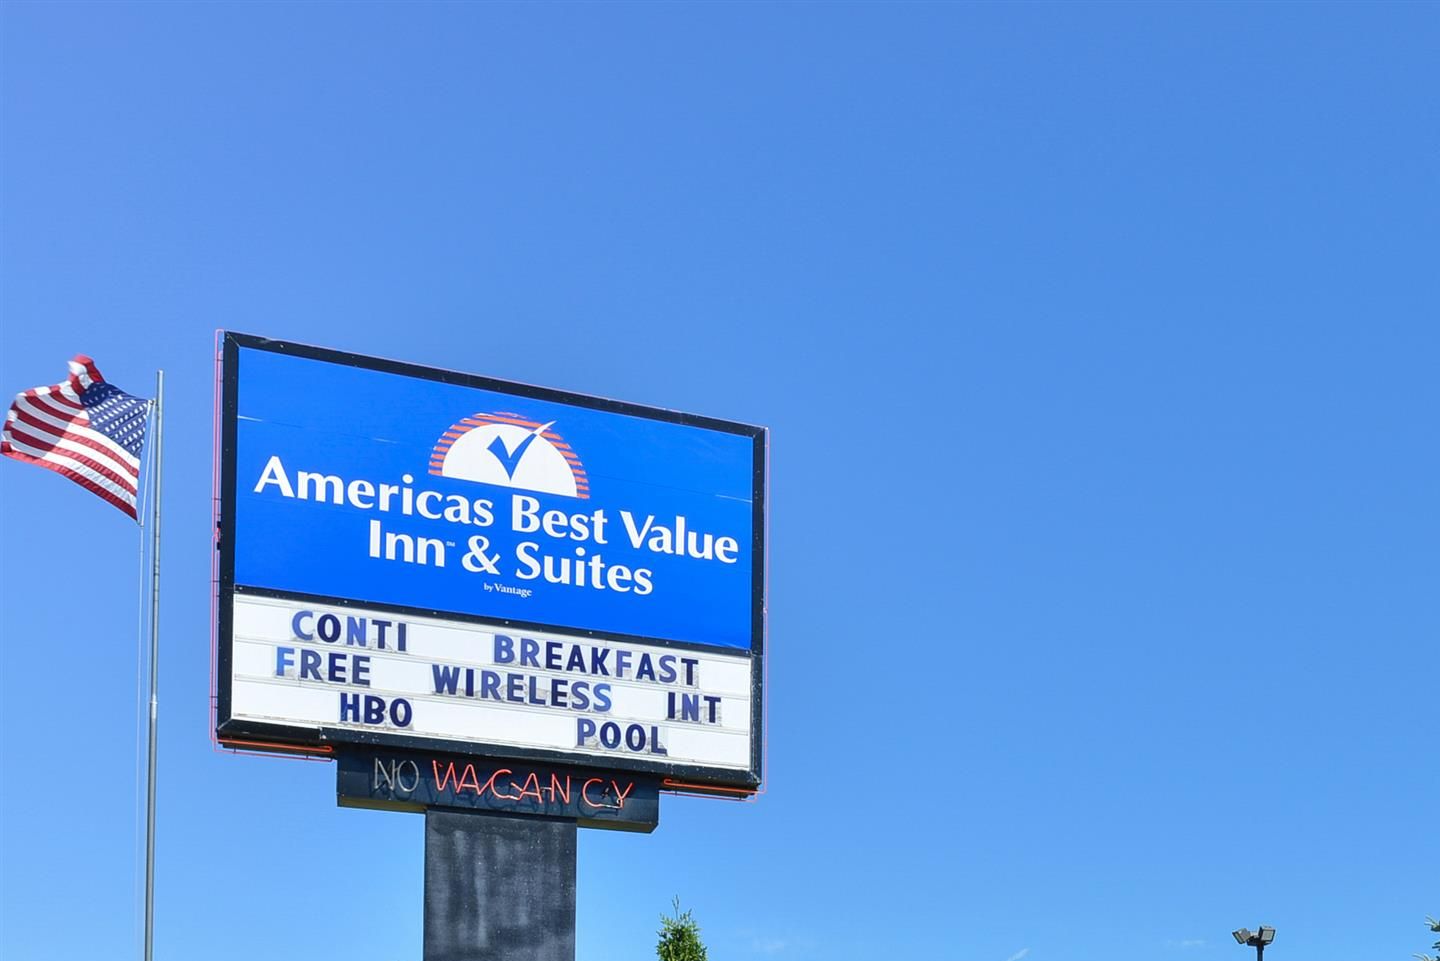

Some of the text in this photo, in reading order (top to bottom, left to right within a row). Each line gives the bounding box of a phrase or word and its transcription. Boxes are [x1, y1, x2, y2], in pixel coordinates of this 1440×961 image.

[254, 455, 739, 564] Americas Best Value
[369, 519, 445, 567] Inn
[461, 535, 501, 575] &
[515, 541, 653, 595] Suites
[483, 582, 532, 598] by Vantage
[276, 646, 722, 724] FREE WIRELESS INT
[292, 610, 699, 686] CONTI BREAKFAST
[340, 692, 668, 756] HBO POOL
[374, 757, 633, 809] NO VACANCY
